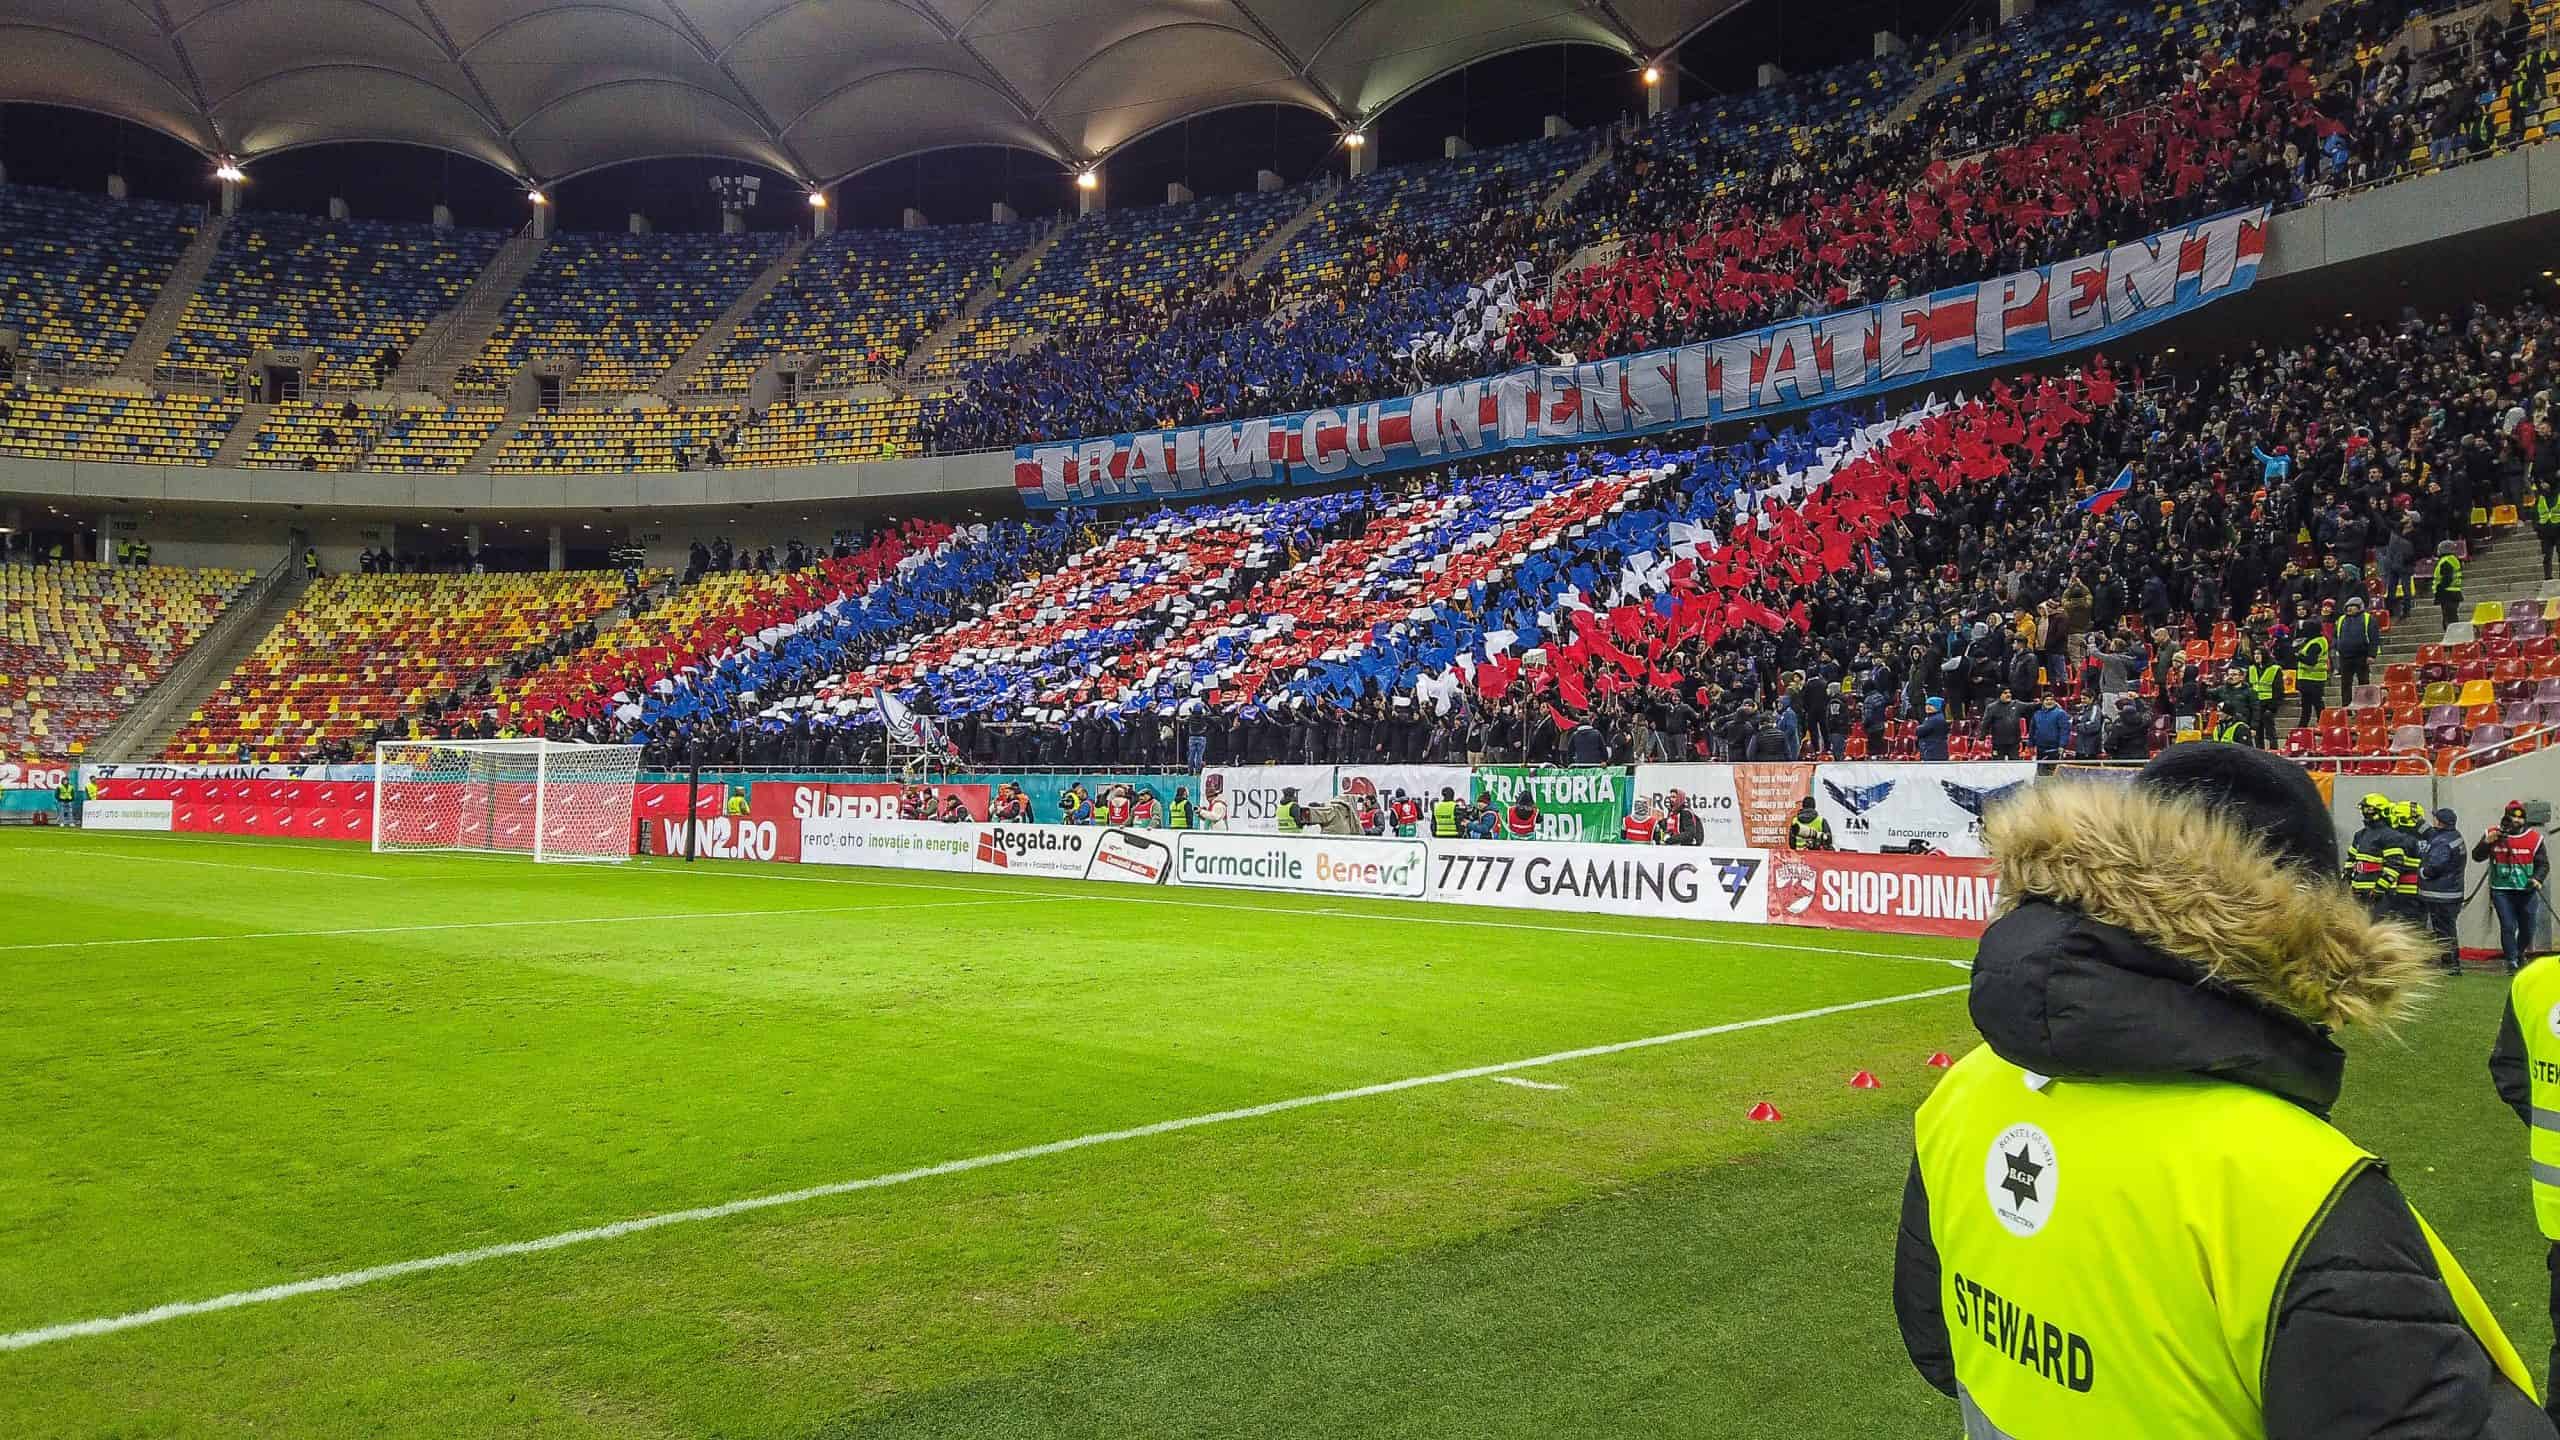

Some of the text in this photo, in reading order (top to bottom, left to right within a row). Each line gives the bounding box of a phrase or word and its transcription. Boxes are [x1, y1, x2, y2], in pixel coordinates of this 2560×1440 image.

[1032, 207, 2264, 501] TRAIM CU INTENSITATE PENT
[1231, 788, 1302, 819] PSB
[1482, 773, 1615, 804] TRATTORIA
[1652, 792, 1732, 810] Reata.ro
[663, 815, 777, 860] WN2.RO
[1536, 813, 1583, 841] RDI
[1845, 817, 1870, 830] FAN
[926, 837, 969, 855] energie
[993, 828, 1082, 856] Regata.ro
[1182, 847, 1302, 879] Farmaciile
[1316, 852, 1409, 886] Beneva
[1438, 854, 1699, 903] 7777 GAMING
[1954, 1271, 2095, 1394] STEWARD
